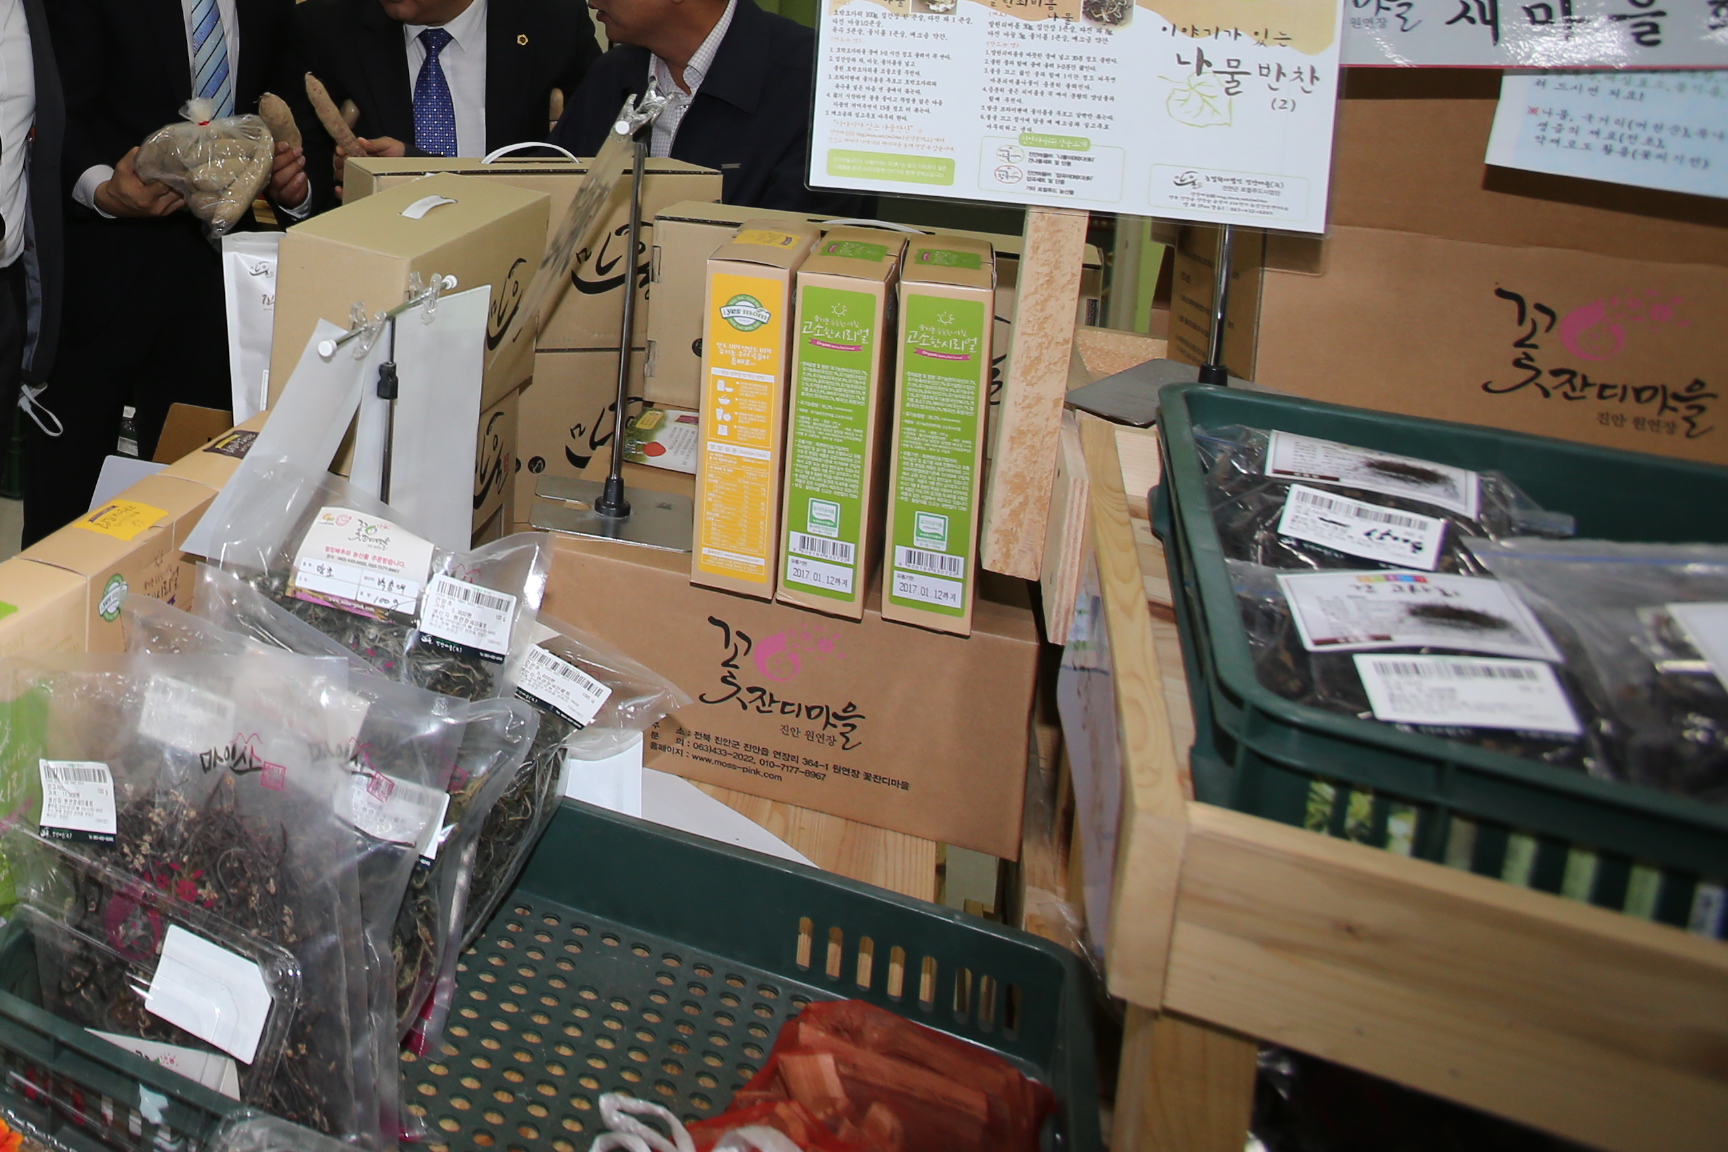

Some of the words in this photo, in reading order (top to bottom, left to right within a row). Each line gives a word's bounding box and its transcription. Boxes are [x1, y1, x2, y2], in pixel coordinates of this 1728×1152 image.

[1161, 23, 1243, 42] 이야기가
[1252, 27, 1293, 48] 있는
[1270, 98, 1297, 112] (2)
[726, 308, 741, 316] yes
[742, 308, 768, 322] mom
[1481, 287, 1719, 439] 꽃잔디마을
[1596, 411, 1625, 428] 진안
[1632, 415, 1677, 435] 원연장
[699, 615, 866, 750] 꽃잔디마을
[779, 723, 802, 739] 진안
[804, 730, 837, 748] 원연장
[200, 741, 265, 776] 마이산
[649, 740, 684, 758] 홈페이지
[691, 753, 783, 782] www.moss-pink.com
[650, 730, 660, 740] 문
[692, 741, 756, 765] 063)433-2022,
[758, 757, 827, 782] 010-7177-8967
[675, 726, 685, 737] 소
[693, 730, 713, 743] 전북
[714, 735, 741, 749] 진안군
[743, 741, 770, 757] 진안읍
[772, 748, 800, 764] 연장리
[802, 757, 829, 771] 364-1
[832, 763, 861, 779] 원연장
[862, 771, 911, 791] 꽃잔디마을
